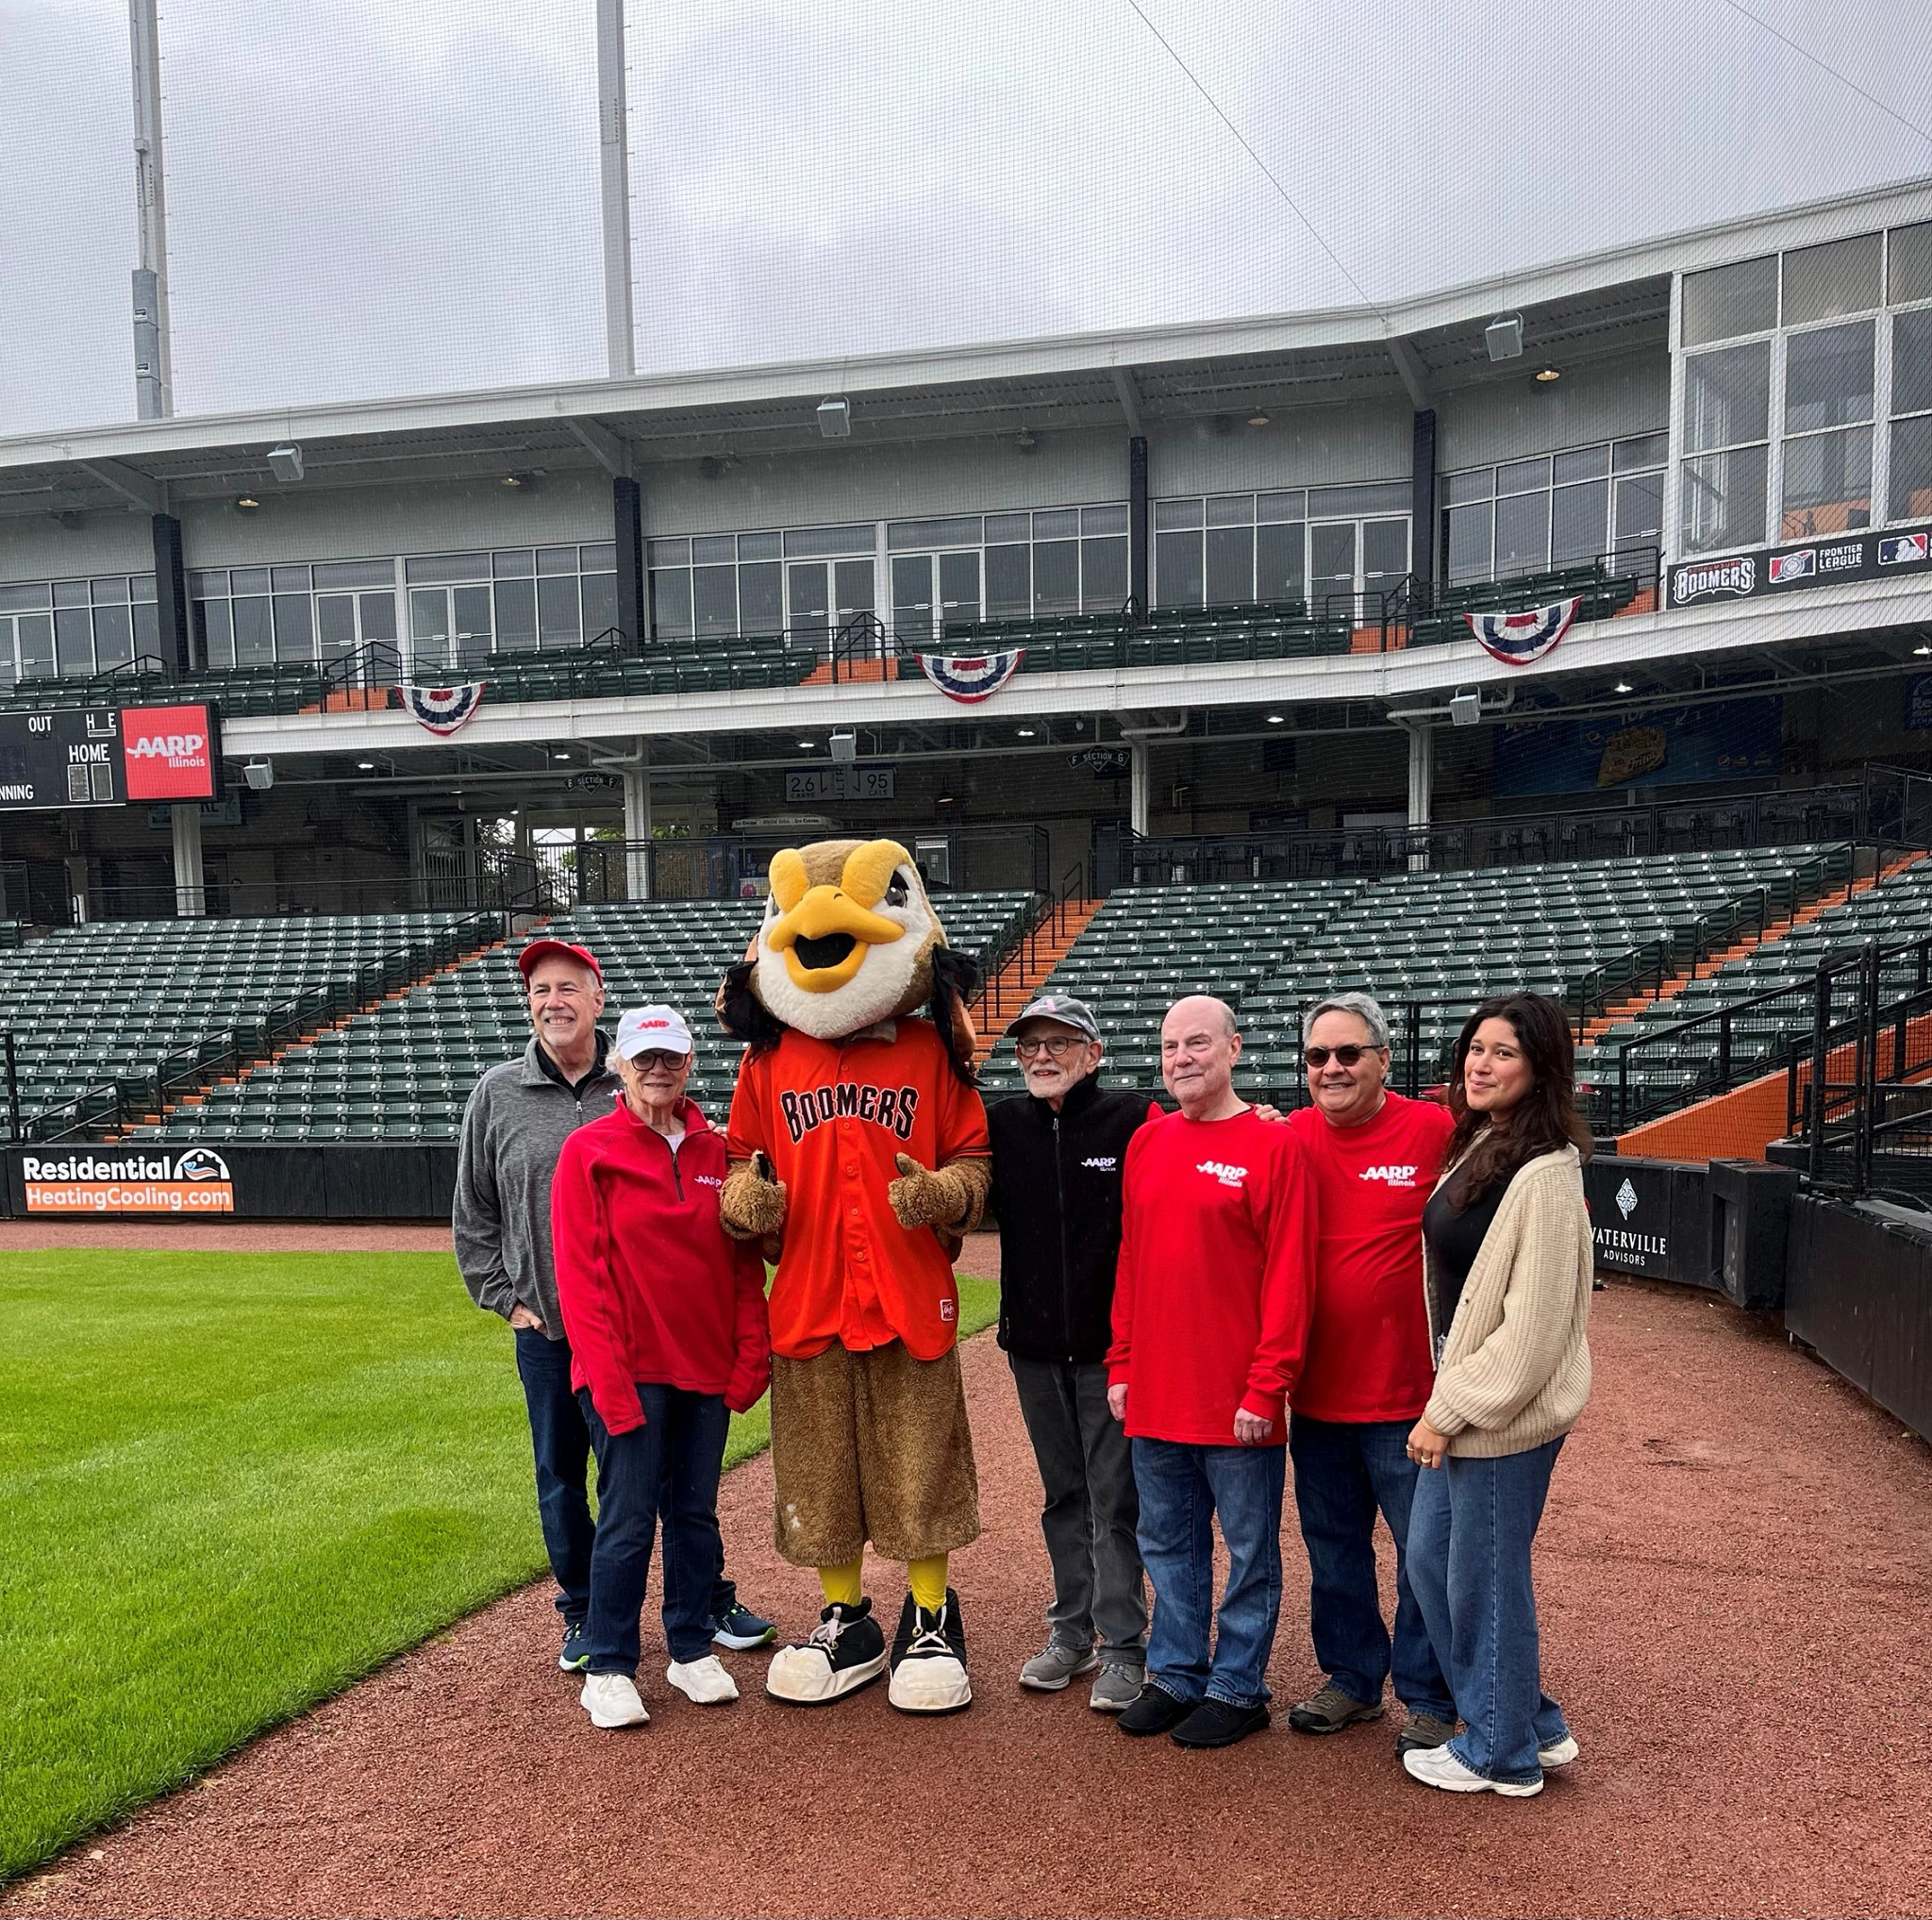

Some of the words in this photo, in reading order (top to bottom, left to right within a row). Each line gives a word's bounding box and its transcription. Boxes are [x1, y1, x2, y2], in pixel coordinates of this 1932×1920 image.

[1820, 543, 1863, 558] FRONTIER
[1820, 553, 1862, 570] LEAGUE
[1676, 560, 1752, 600] BOOMERS
[28, 716, 52, 732] OUT
[86, 713, 95, 729] H
[108, 712, 117, 728] E
[68, 743, 110, 763] HOME
[126, 734, 206, 759] AARP
[168, 757, 206, 768] Illinois
[1072, 756, 1077, 765] F
[1083, 752, 1112, 761] SECTION
[1118, 753, 1124, 763] G
[568, 778, 573, 788] E
[577, 776, 604, 785] SECTION
[608, 777, 614, 787] F
[791, 776, 815, 793] 2.6
[867, 774, 888, 789] 95
[835, 763, 845, 802] ULTR
[636, 1020, 670, 1029] AARP
[781, 1082, 919, 1144] BOOMERS
[23, 1156, 171, 1180] Residential
[1081, 1157, 1116, 1167] AARP
[1195, 1160, 1249, 1180] AARP
[1358, 1165, 1417, 1180] AARP
[1388, 1178, 1416, 1187] Illinois
[27, 1186, 231, 1210] HeatingCooling.com
[1604, 1248, 1645, 1266] ADVISORS
